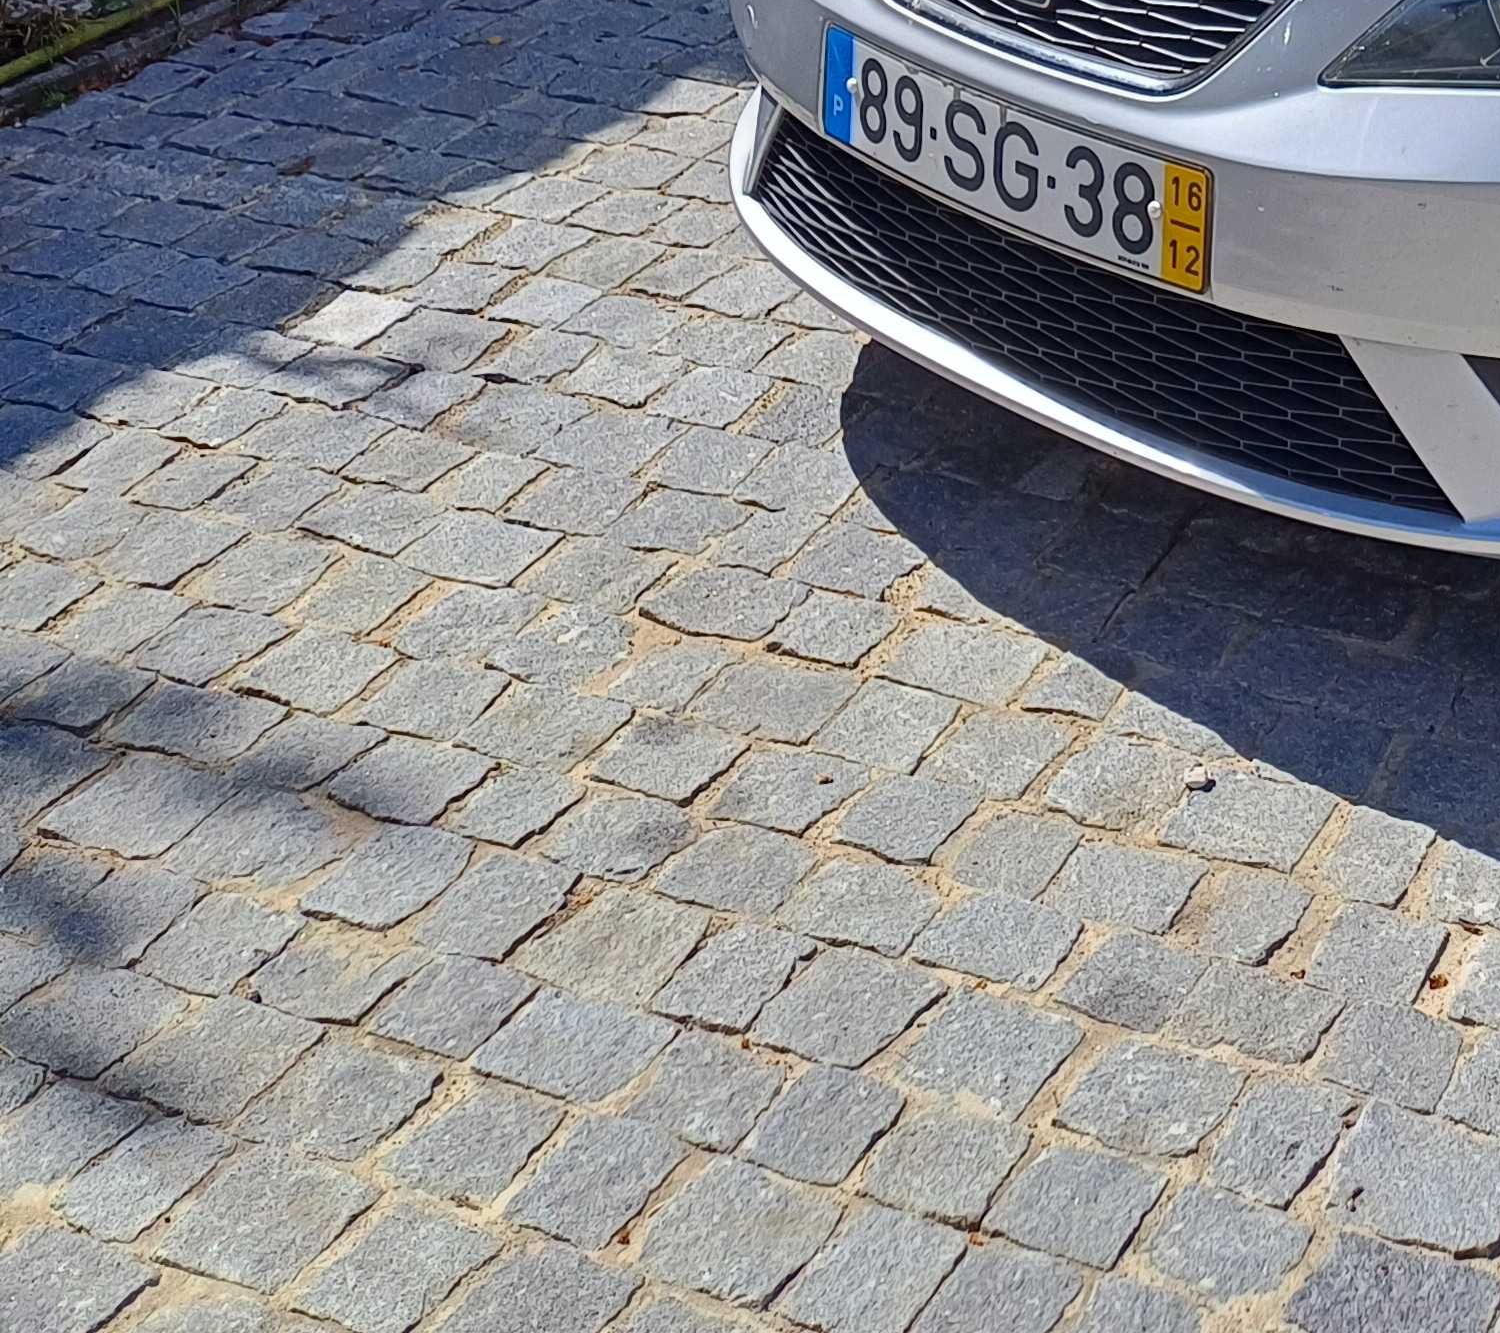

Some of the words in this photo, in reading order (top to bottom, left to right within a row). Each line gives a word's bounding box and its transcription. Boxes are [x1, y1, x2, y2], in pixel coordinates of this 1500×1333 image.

[832, 93, 844, 116] P
[1171, 176, 1203, 212] 16
[1168, 239, 1200, 277] 12
